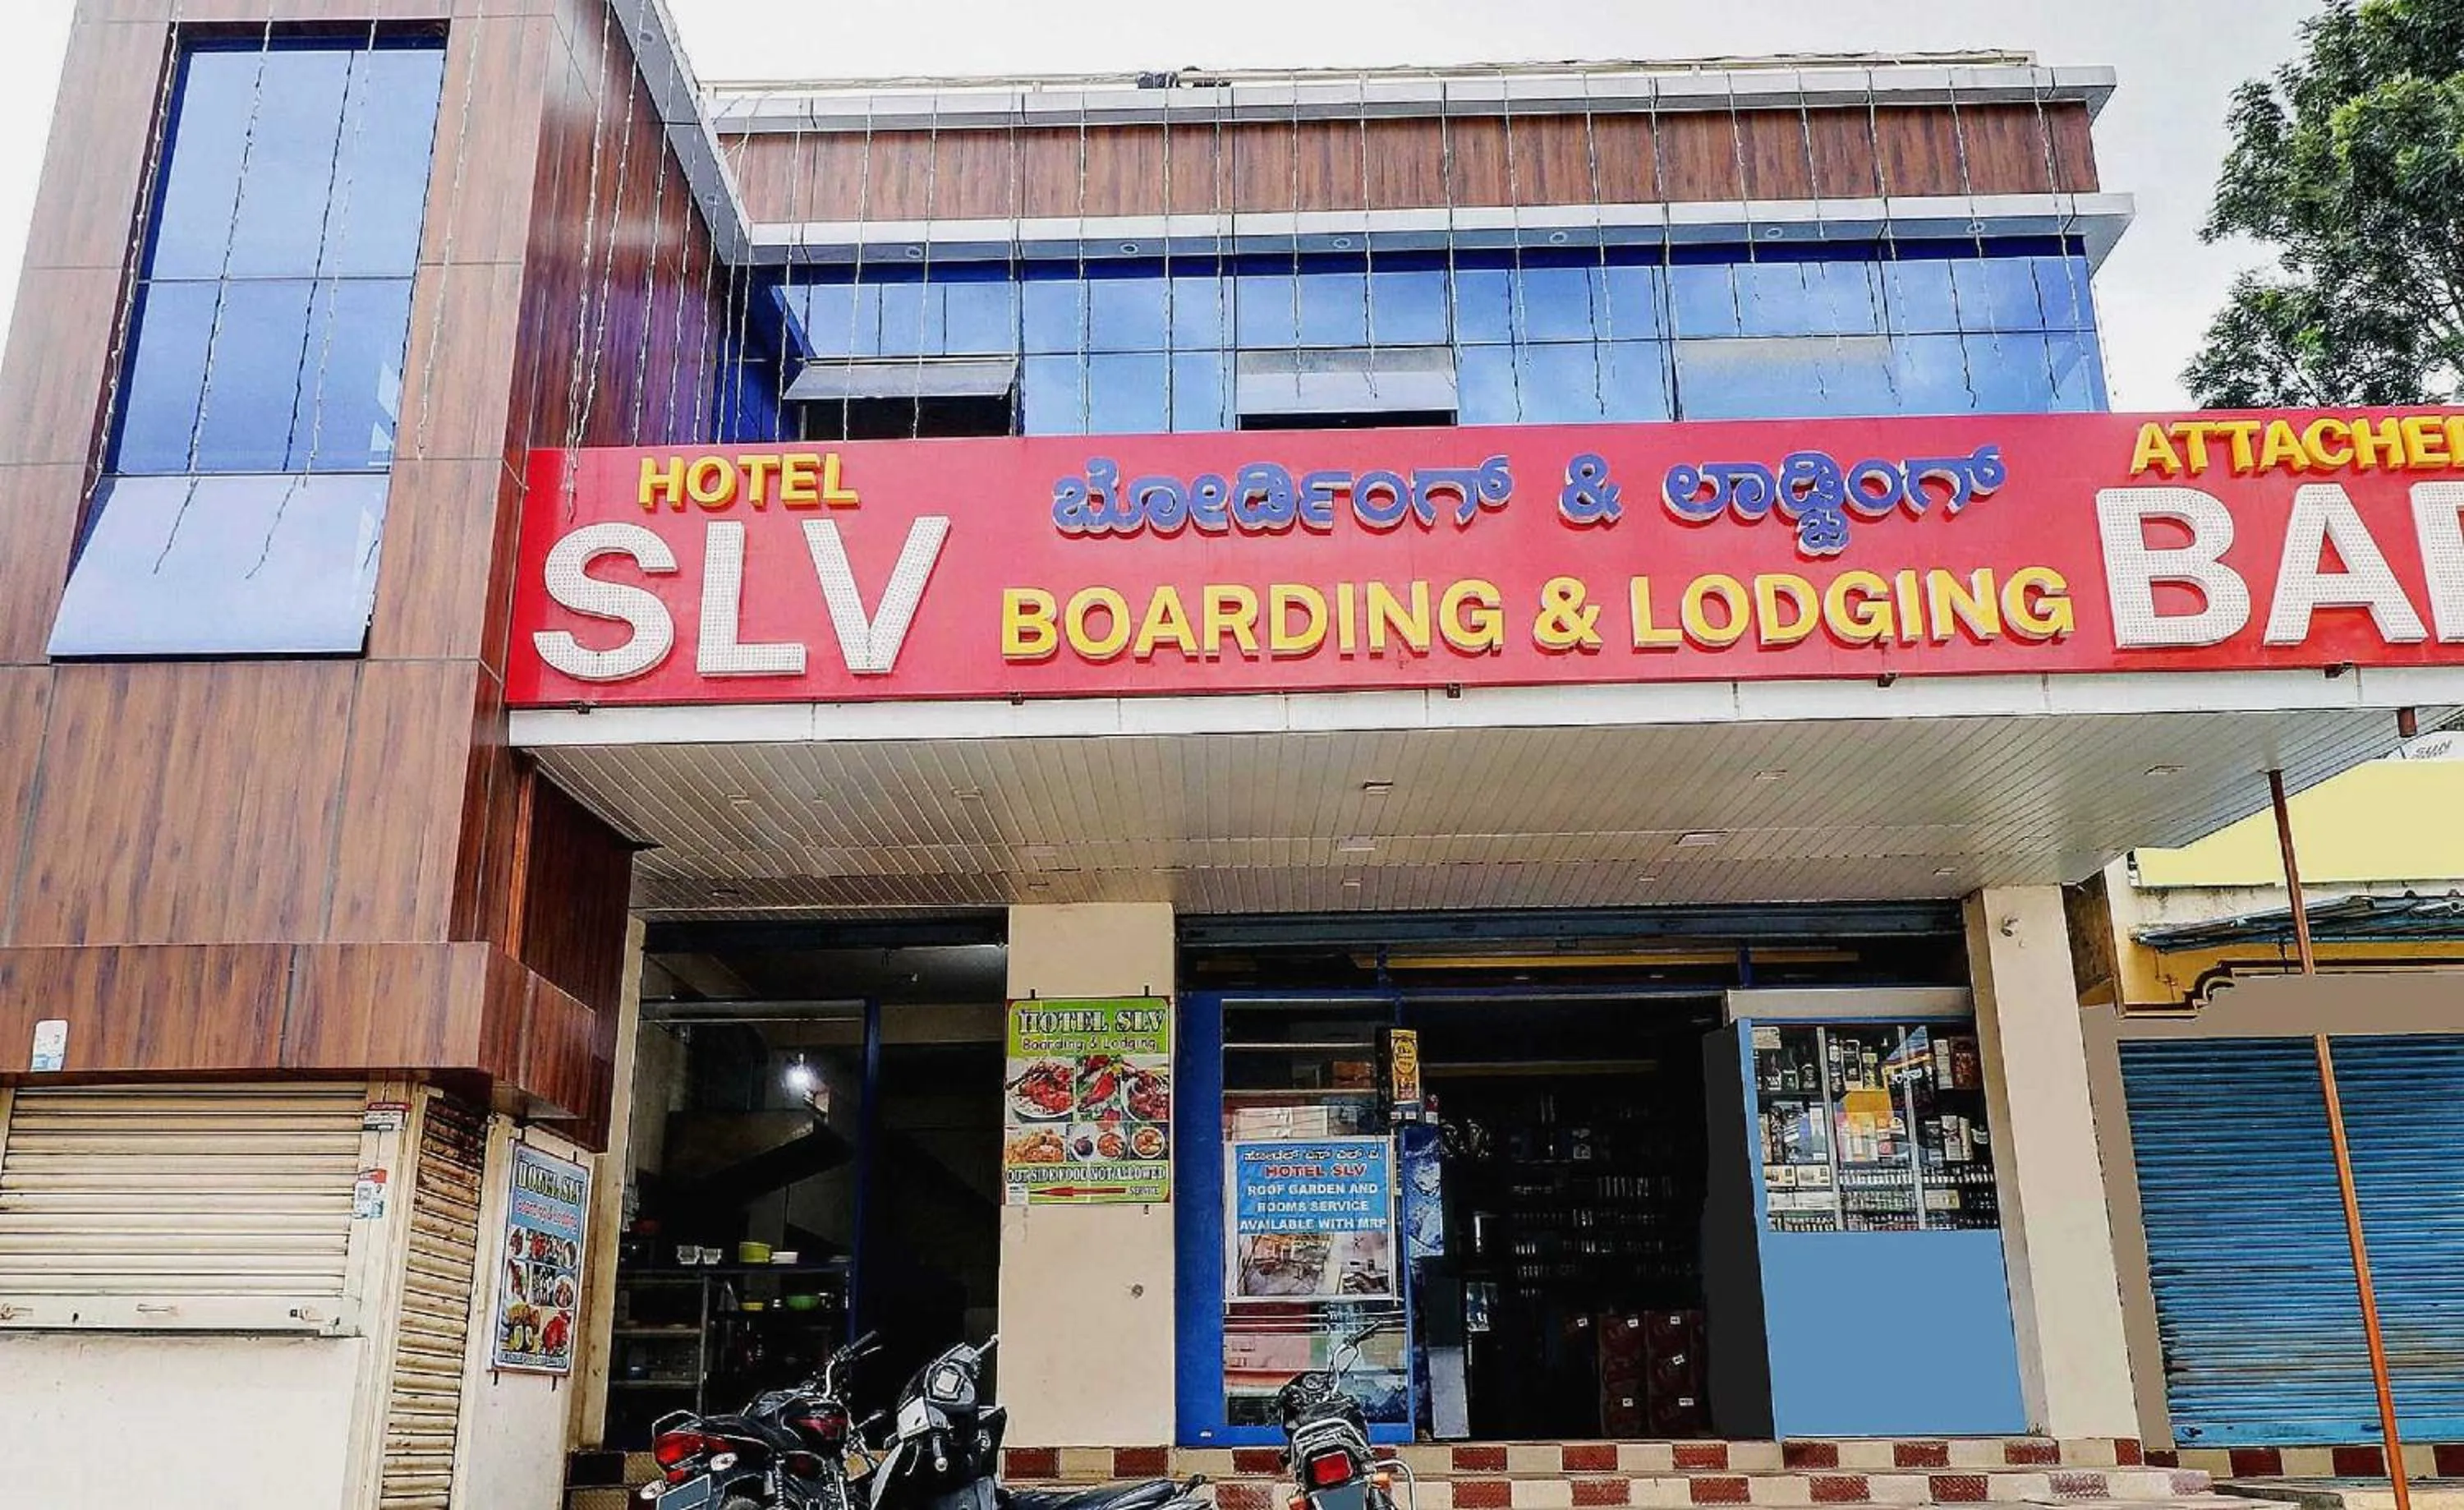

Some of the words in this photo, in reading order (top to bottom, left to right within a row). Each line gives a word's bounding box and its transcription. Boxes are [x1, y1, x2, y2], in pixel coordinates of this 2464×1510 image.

[637, 453, 860, 509] HOTEL
[1560, 453, 1624, 524] &
[533, 516, 950, 681] SLV
[1001, 579, 1505, 660] BOARDING
[1533, 577, 1603, 650] &
[1630, 566, 2075, 649] LODGING
[1018, 1010, 1107, 1034] HOTEL
[1116, 1009, 1165, 1033] SLV
[1023, 1037, 1085, 1052] Boarding
[1104, 1037, 1156, 1052] Lodging
[1264, 1164, 1325, 1177] HOTEL
[1332, 1162, 1367, 1176] SLV
[1248, 1184, 1285, 1195] ROOF
[1289, 1184, 1346, 1195] GARDEN
[1349, 1183, 1378, 1194] AND
[1257, 1200, 1306, 1212] ROOMS
[1310, 1200, 1369, 1212] SERVICE
[1239, 1219, 1314, 1231] AVAILABLE
[1318, 1218, 1354, 1230] WITH
[1358, 1218, 1387, 1229] MRP
